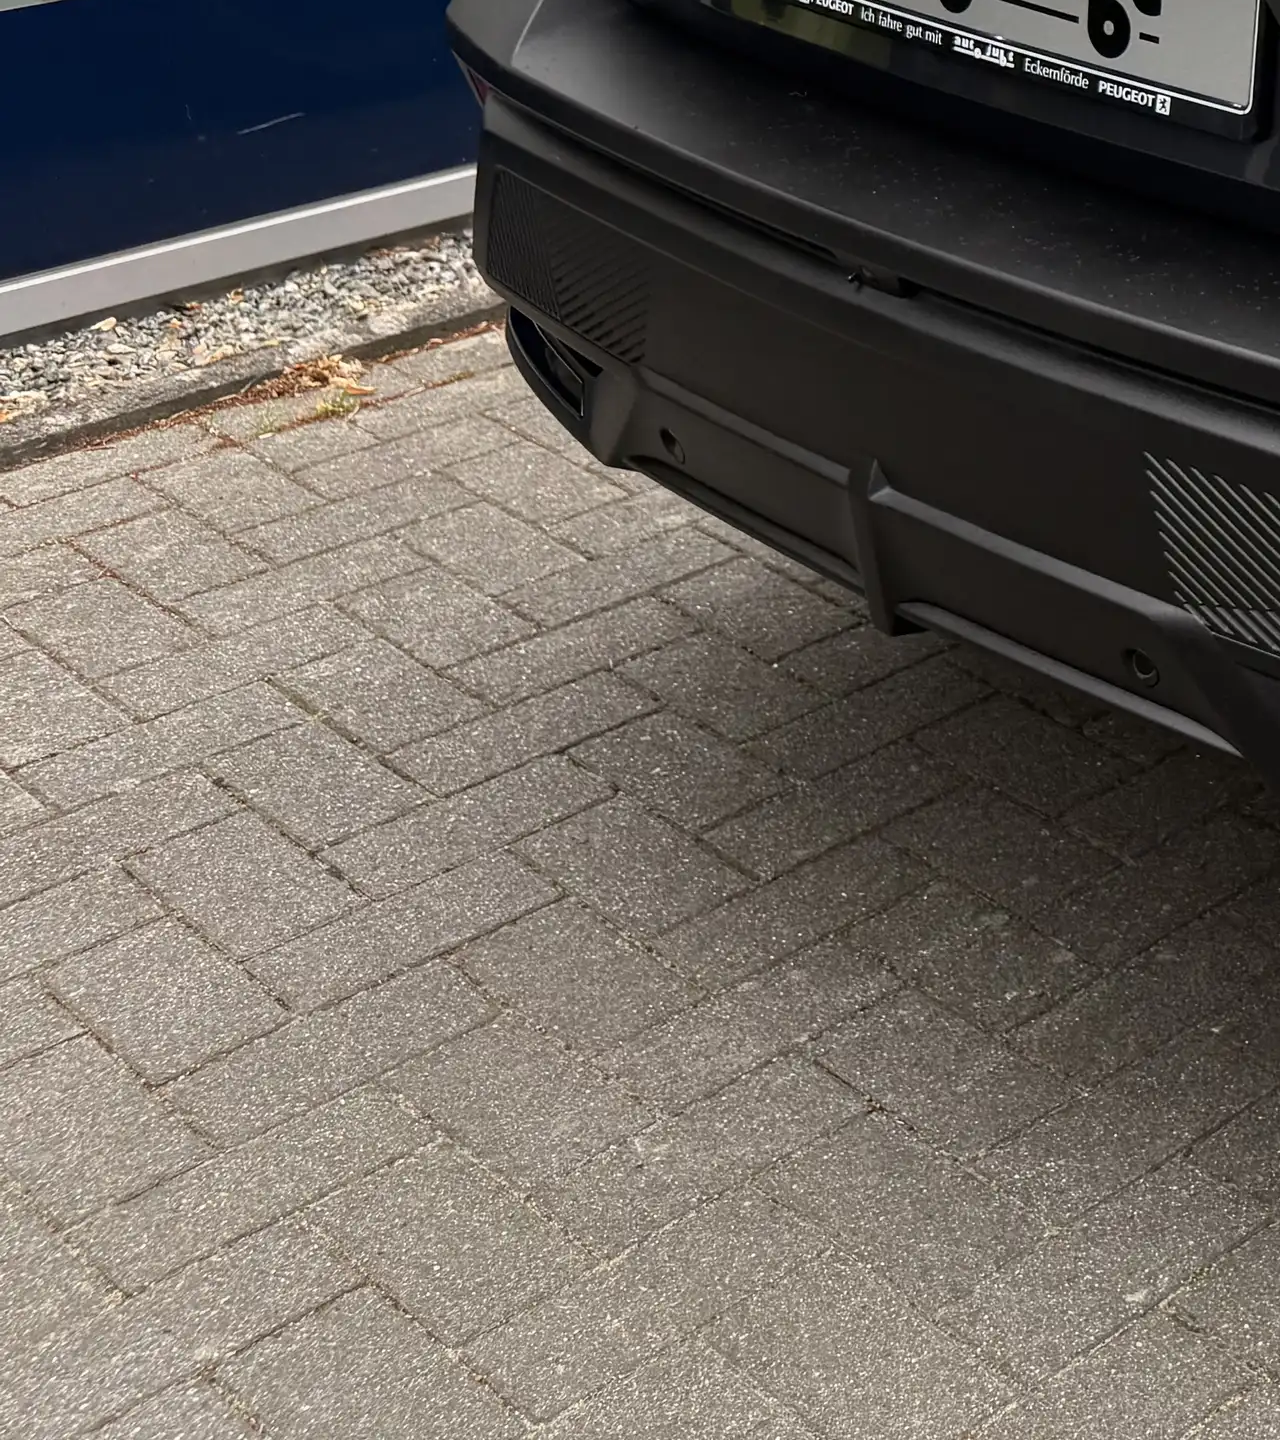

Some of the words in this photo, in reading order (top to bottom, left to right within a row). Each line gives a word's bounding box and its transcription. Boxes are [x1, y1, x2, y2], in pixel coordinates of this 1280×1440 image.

[861, 7, 875, 23] Ich
[878, 11, 903, 32] fahre
[905, 24, 922, 38] gut
[925, 30, 942, 45] mit
[1024, 57, 1089, 89] Eckernförde
[1098, 80, 1155, 108] PEUGEOT
